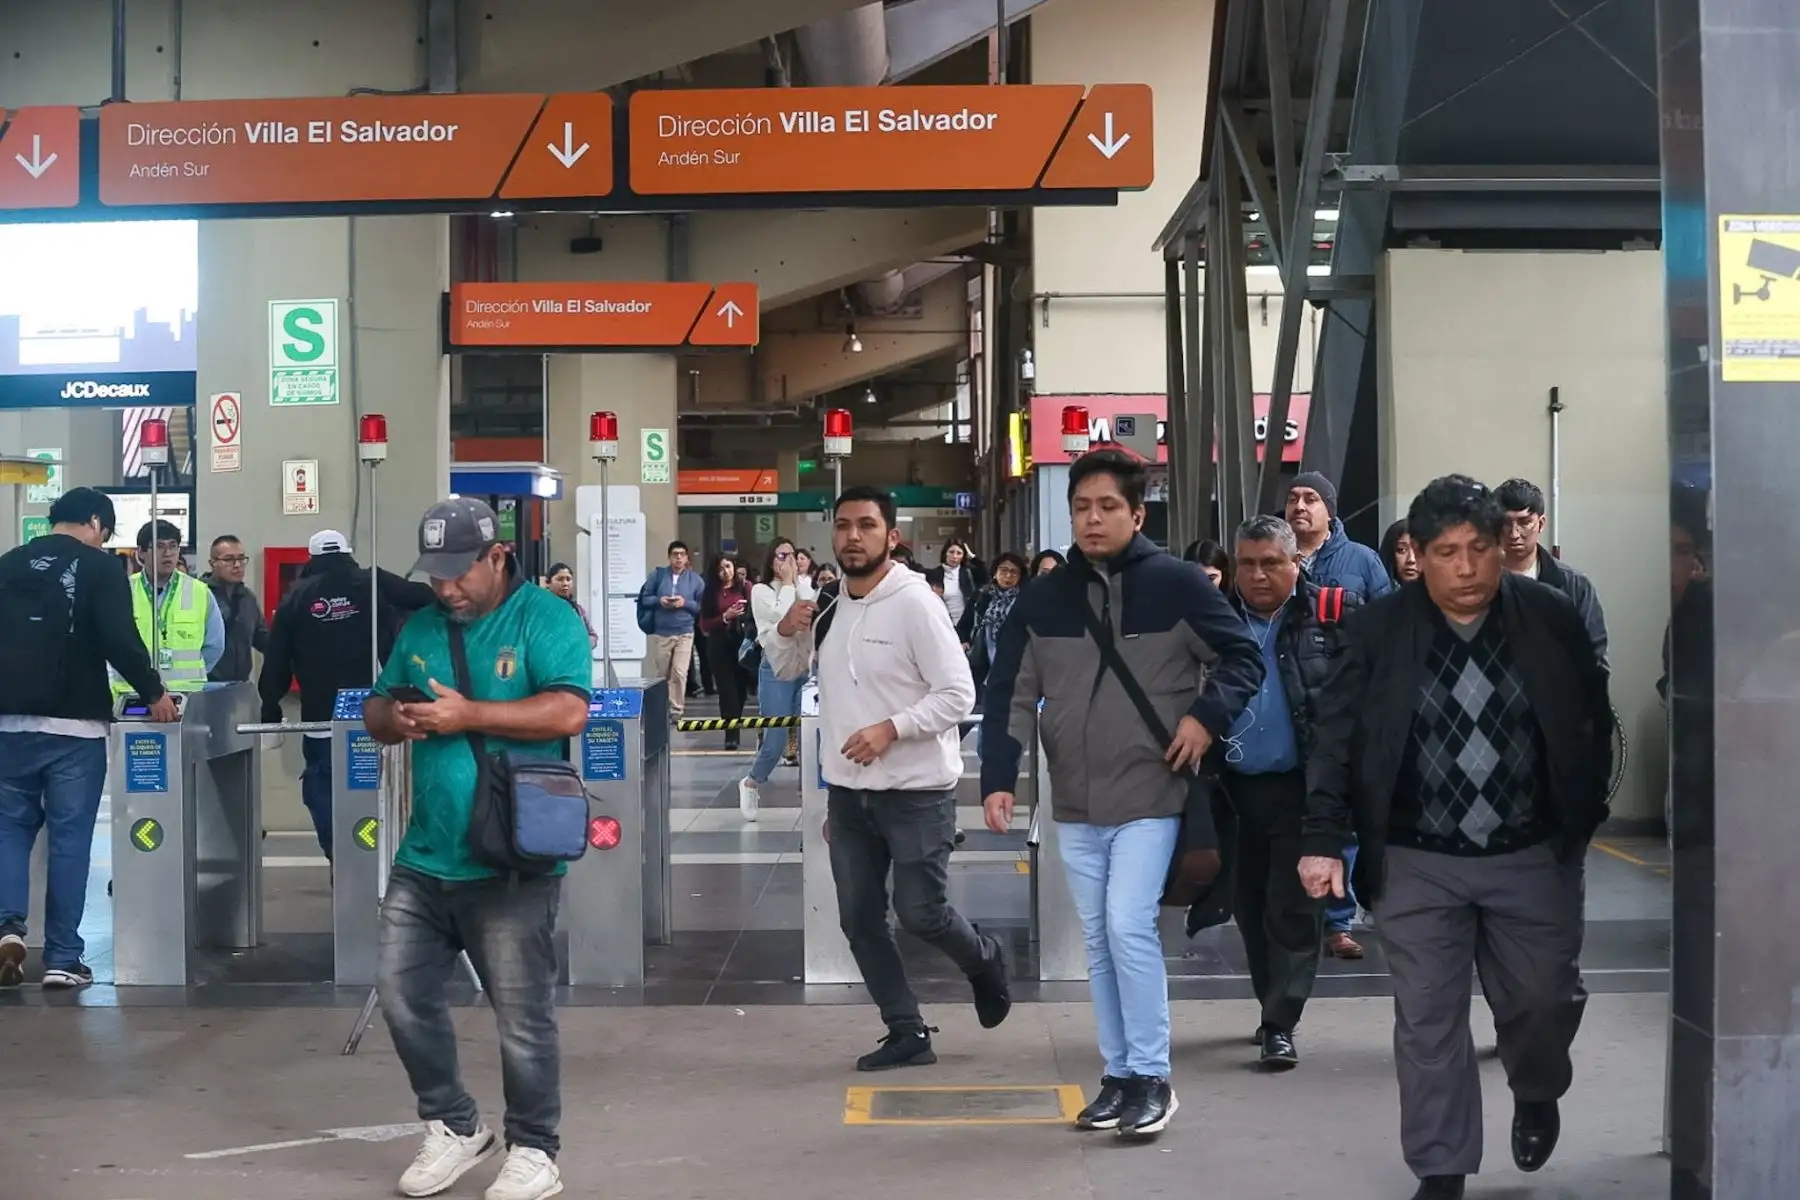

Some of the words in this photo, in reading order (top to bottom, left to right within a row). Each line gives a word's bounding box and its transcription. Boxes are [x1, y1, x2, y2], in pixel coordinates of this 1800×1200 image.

[659, 112, 771, 137] Dirección
[779, 111, 836, 133] Villa
[844, 110, 869, 132] El
[878, 108, 998, 132] Salvador
[127, 122, 236, 146] Dirección
[244, 121, 299, 144] Villa
[308, 121, 332, 143] El
[340, 119, 458, 143] Salvador
[657, 150, 709, 166] Andén
[714, 149, 741, 165] Sur
[129, 162, 179, 178] Andén
[183, 161, 210, 177] Sur
[465, 299, 529, 313] Dirección
[532, 299, 563, 313] Villa
[567, 299, 581, 313] El
[585, 299, 652, 313] Salvador
[495, 318, 510, 329] Sur
[282, 307, 325, 362] S
[61, 381, 150, 398] JCDecaux
[647, 433, 664, 461] S
[759, 517, 770, 532] S
